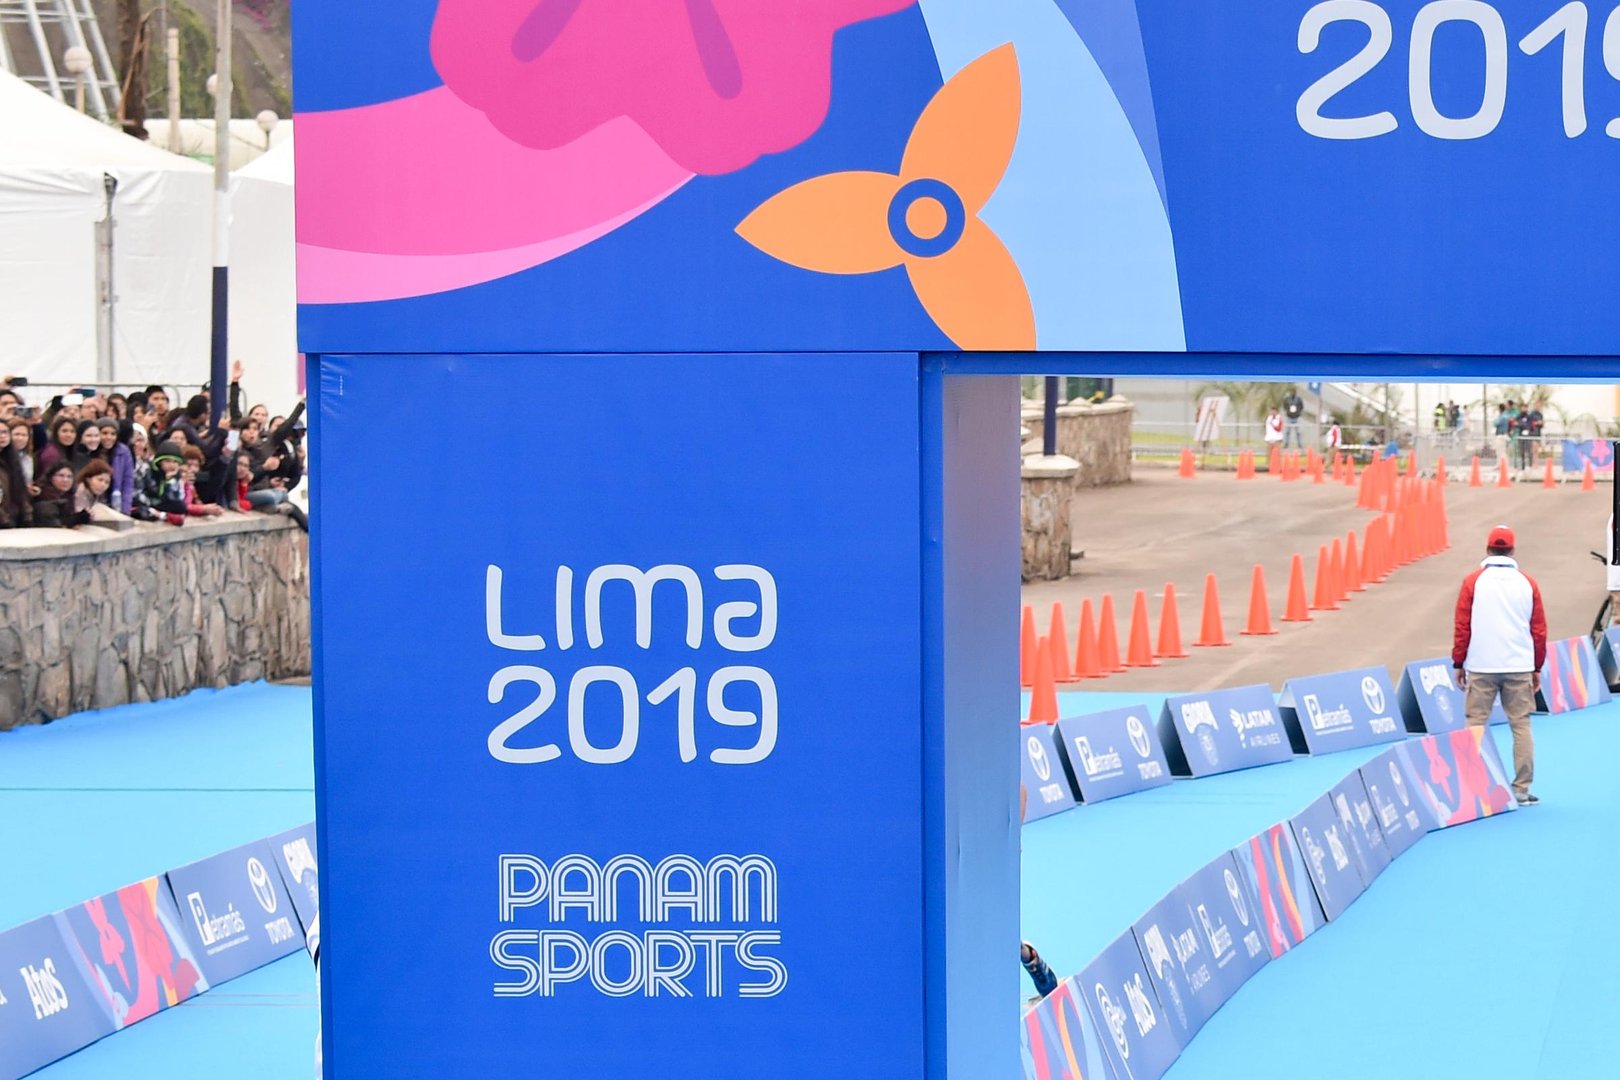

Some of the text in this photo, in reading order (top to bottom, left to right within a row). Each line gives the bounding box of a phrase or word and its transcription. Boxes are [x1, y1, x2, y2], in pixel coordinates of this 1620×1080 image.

[487, 665, 778, 764] 2019
[499, 854, 778, 923] PANAM
[20, 958, 69, 1020] Atos
[489, 930, 788, 997] SPORTS
